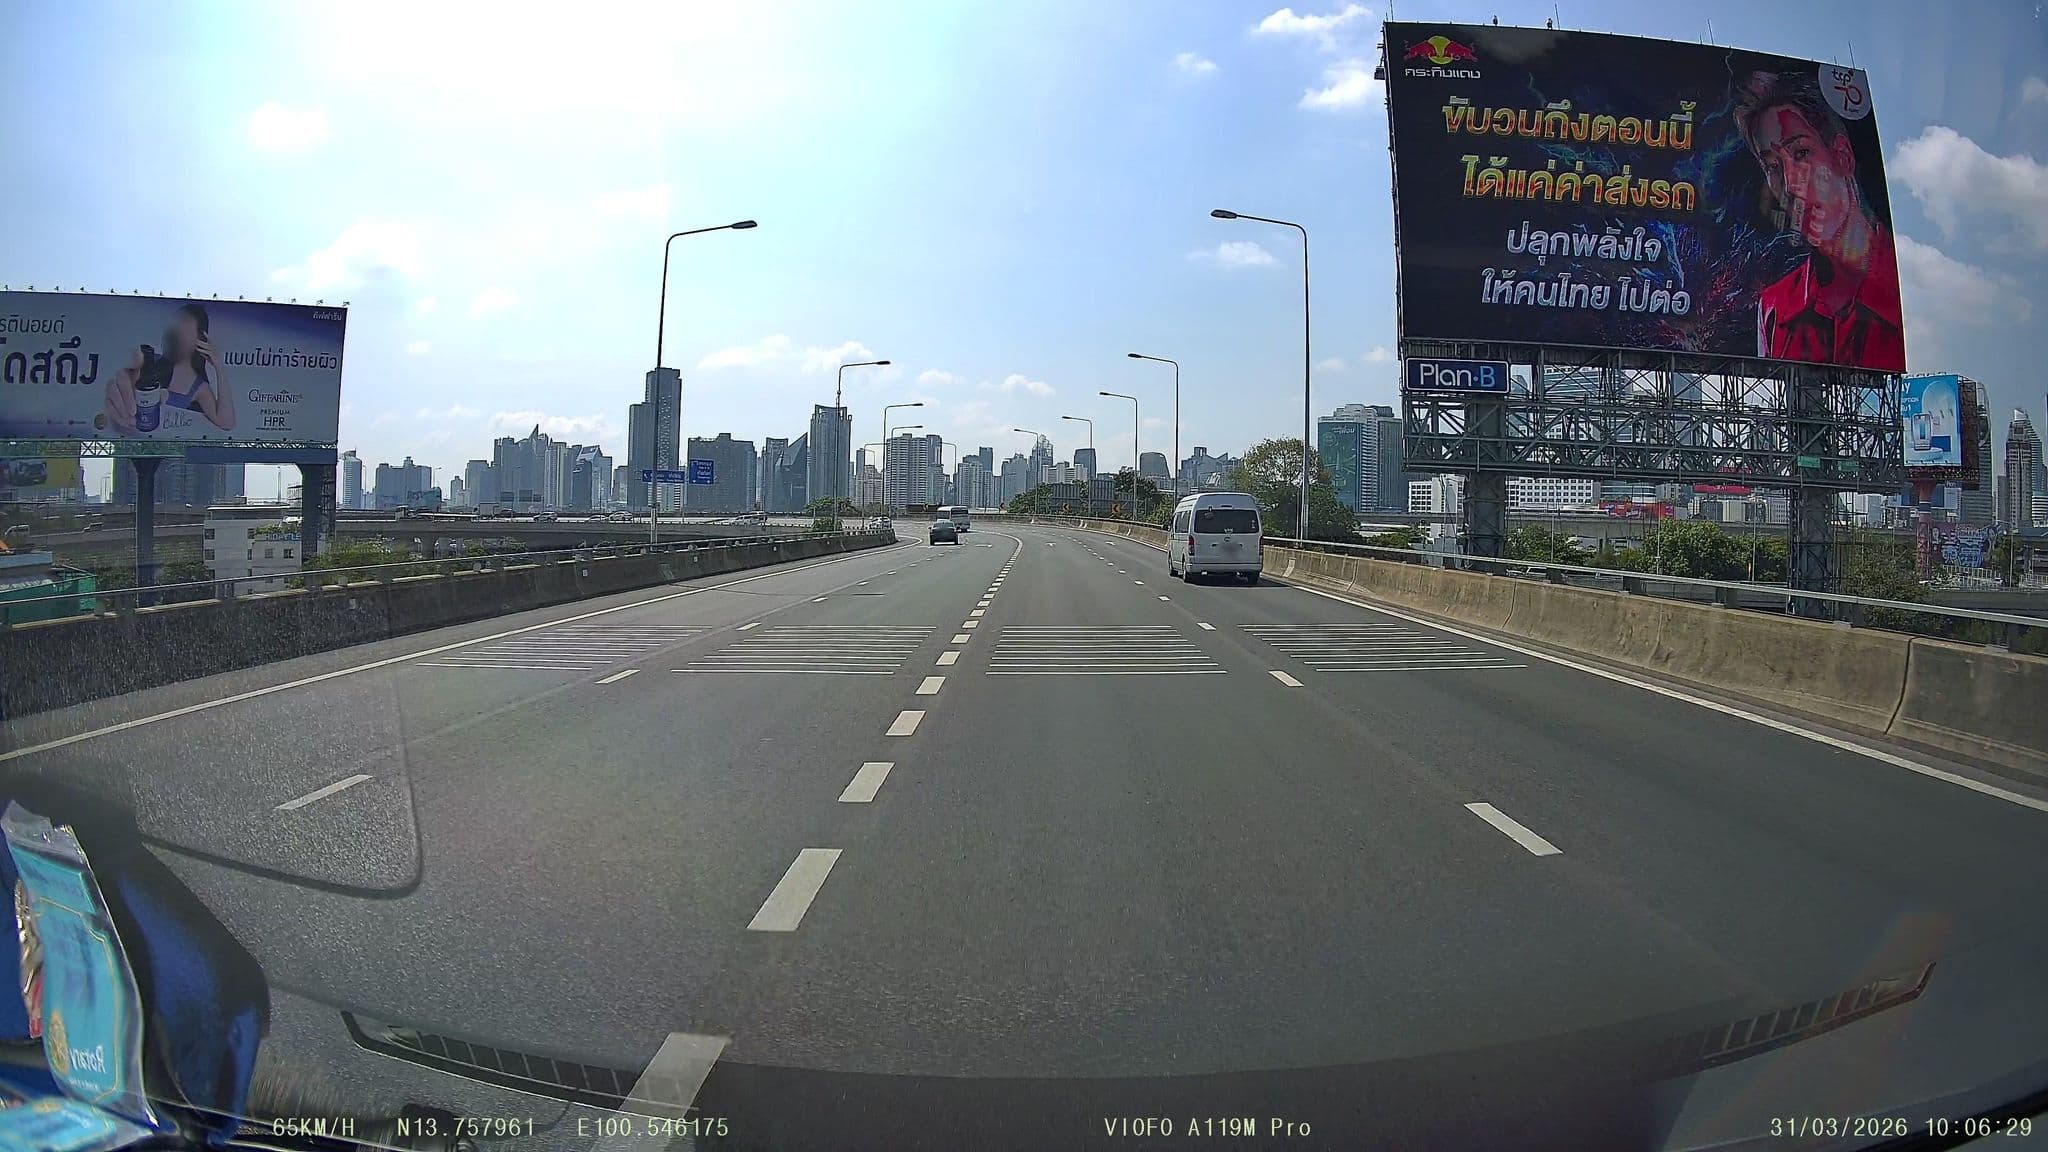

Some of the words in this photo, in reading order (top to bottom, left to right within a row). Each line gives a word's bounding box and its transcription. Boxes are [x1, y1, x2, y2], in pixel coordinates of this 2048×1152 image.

[1404, 66, 1481, 79] กระทิงแดง
[1442, 95, 1697, 150] ขับวนถึงตอนนี้
[1460, 154, 1696, 211] ได้แค่ค่าส่งรถ
[1507, 220, 1662, 266] ปลุกพลังใจ
[1481, 267, 1611, 310] ให้คนไทย
[1618, 276, 1691, 315] ไปต่อ
[224, 347, 338, 370] แบบไม่ทำร้ายผิว
[263, 416, 286, 427] HPR
